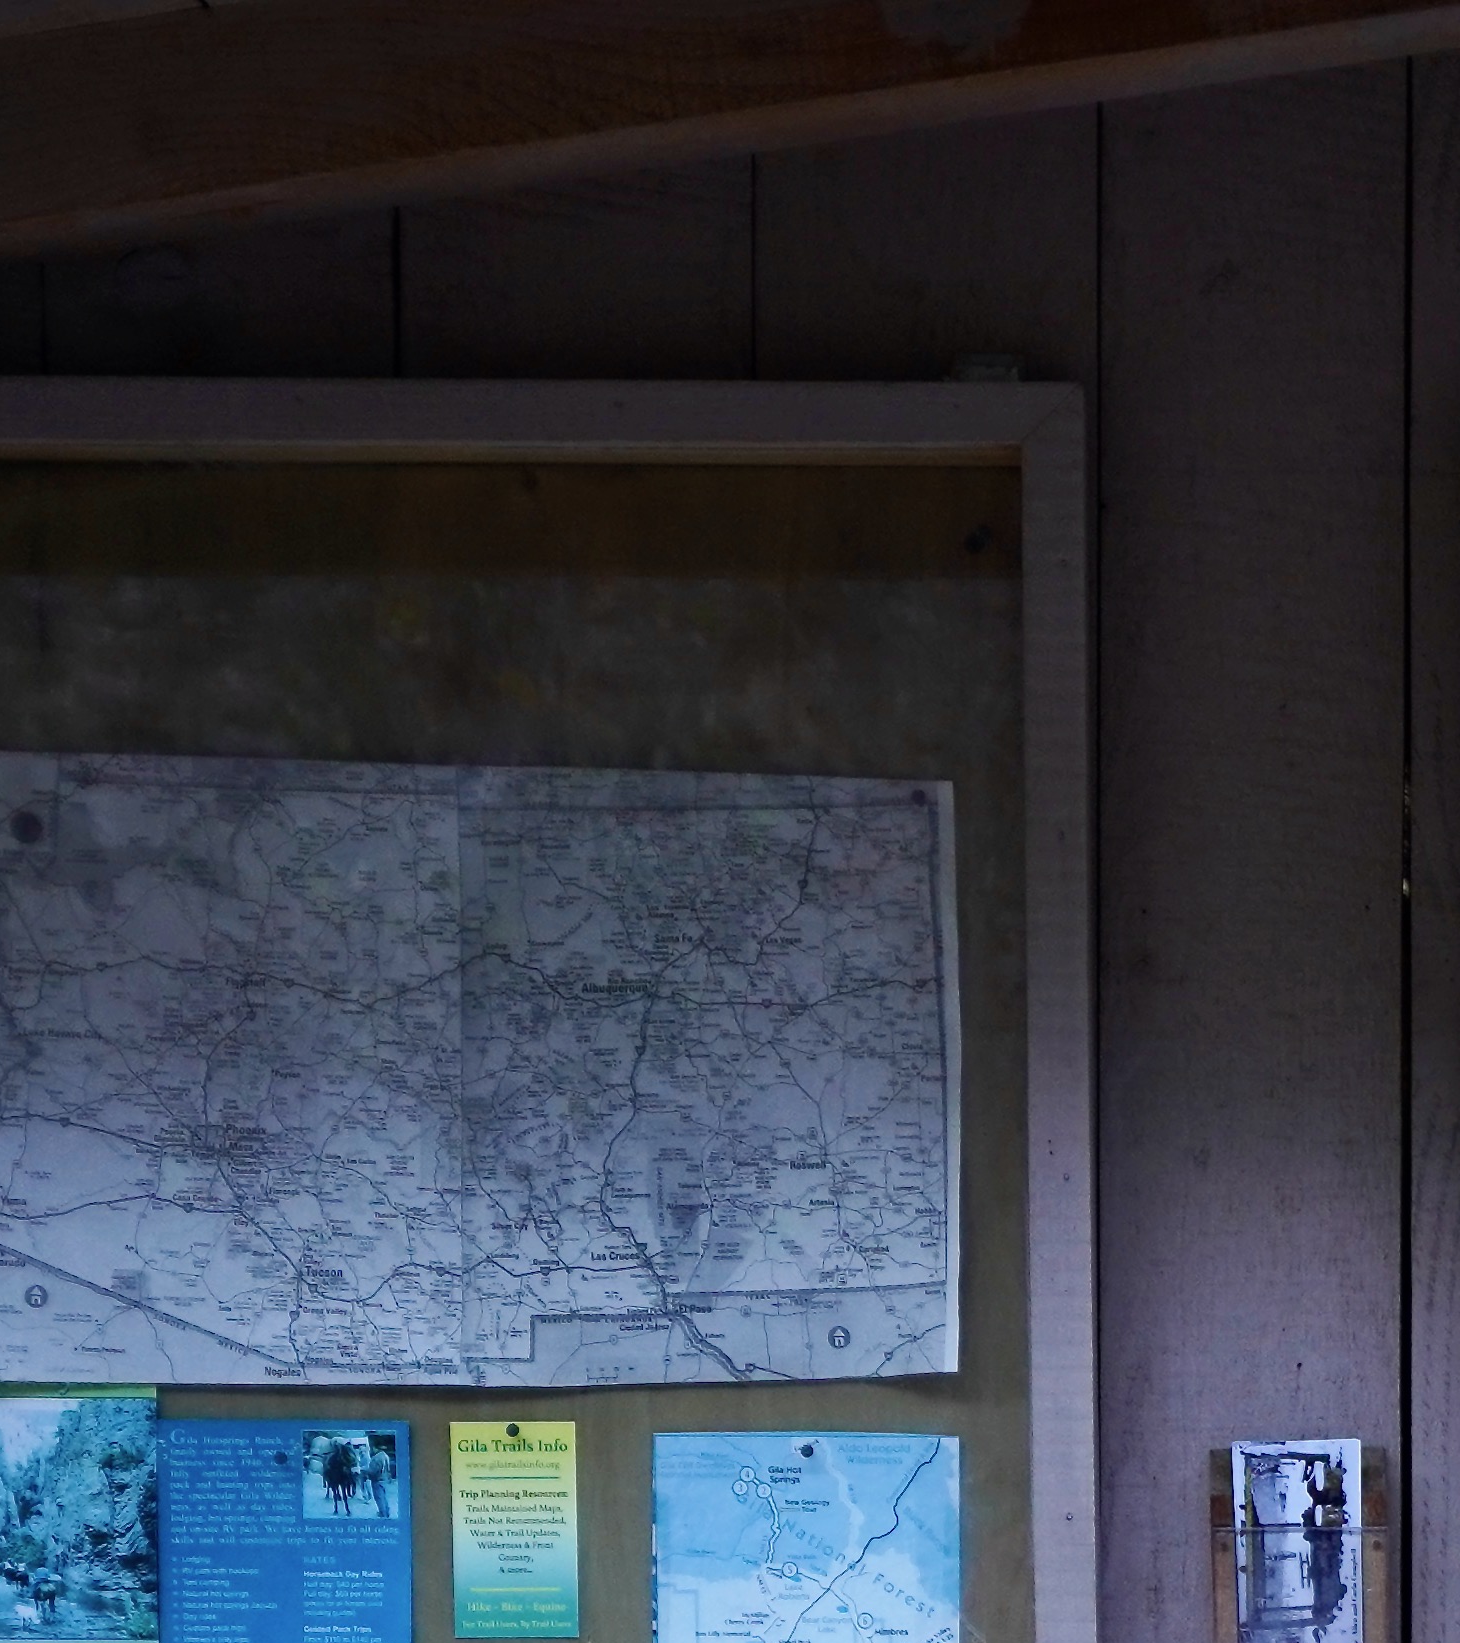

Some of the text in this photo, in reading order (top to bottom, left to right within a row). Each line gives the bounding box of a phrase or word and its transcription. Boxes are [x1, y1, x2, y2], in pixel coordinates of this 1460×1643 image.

[305, 1267, 343, 1279] Tucson
[457, 1438, 568, 1453] Gila Trails Info
